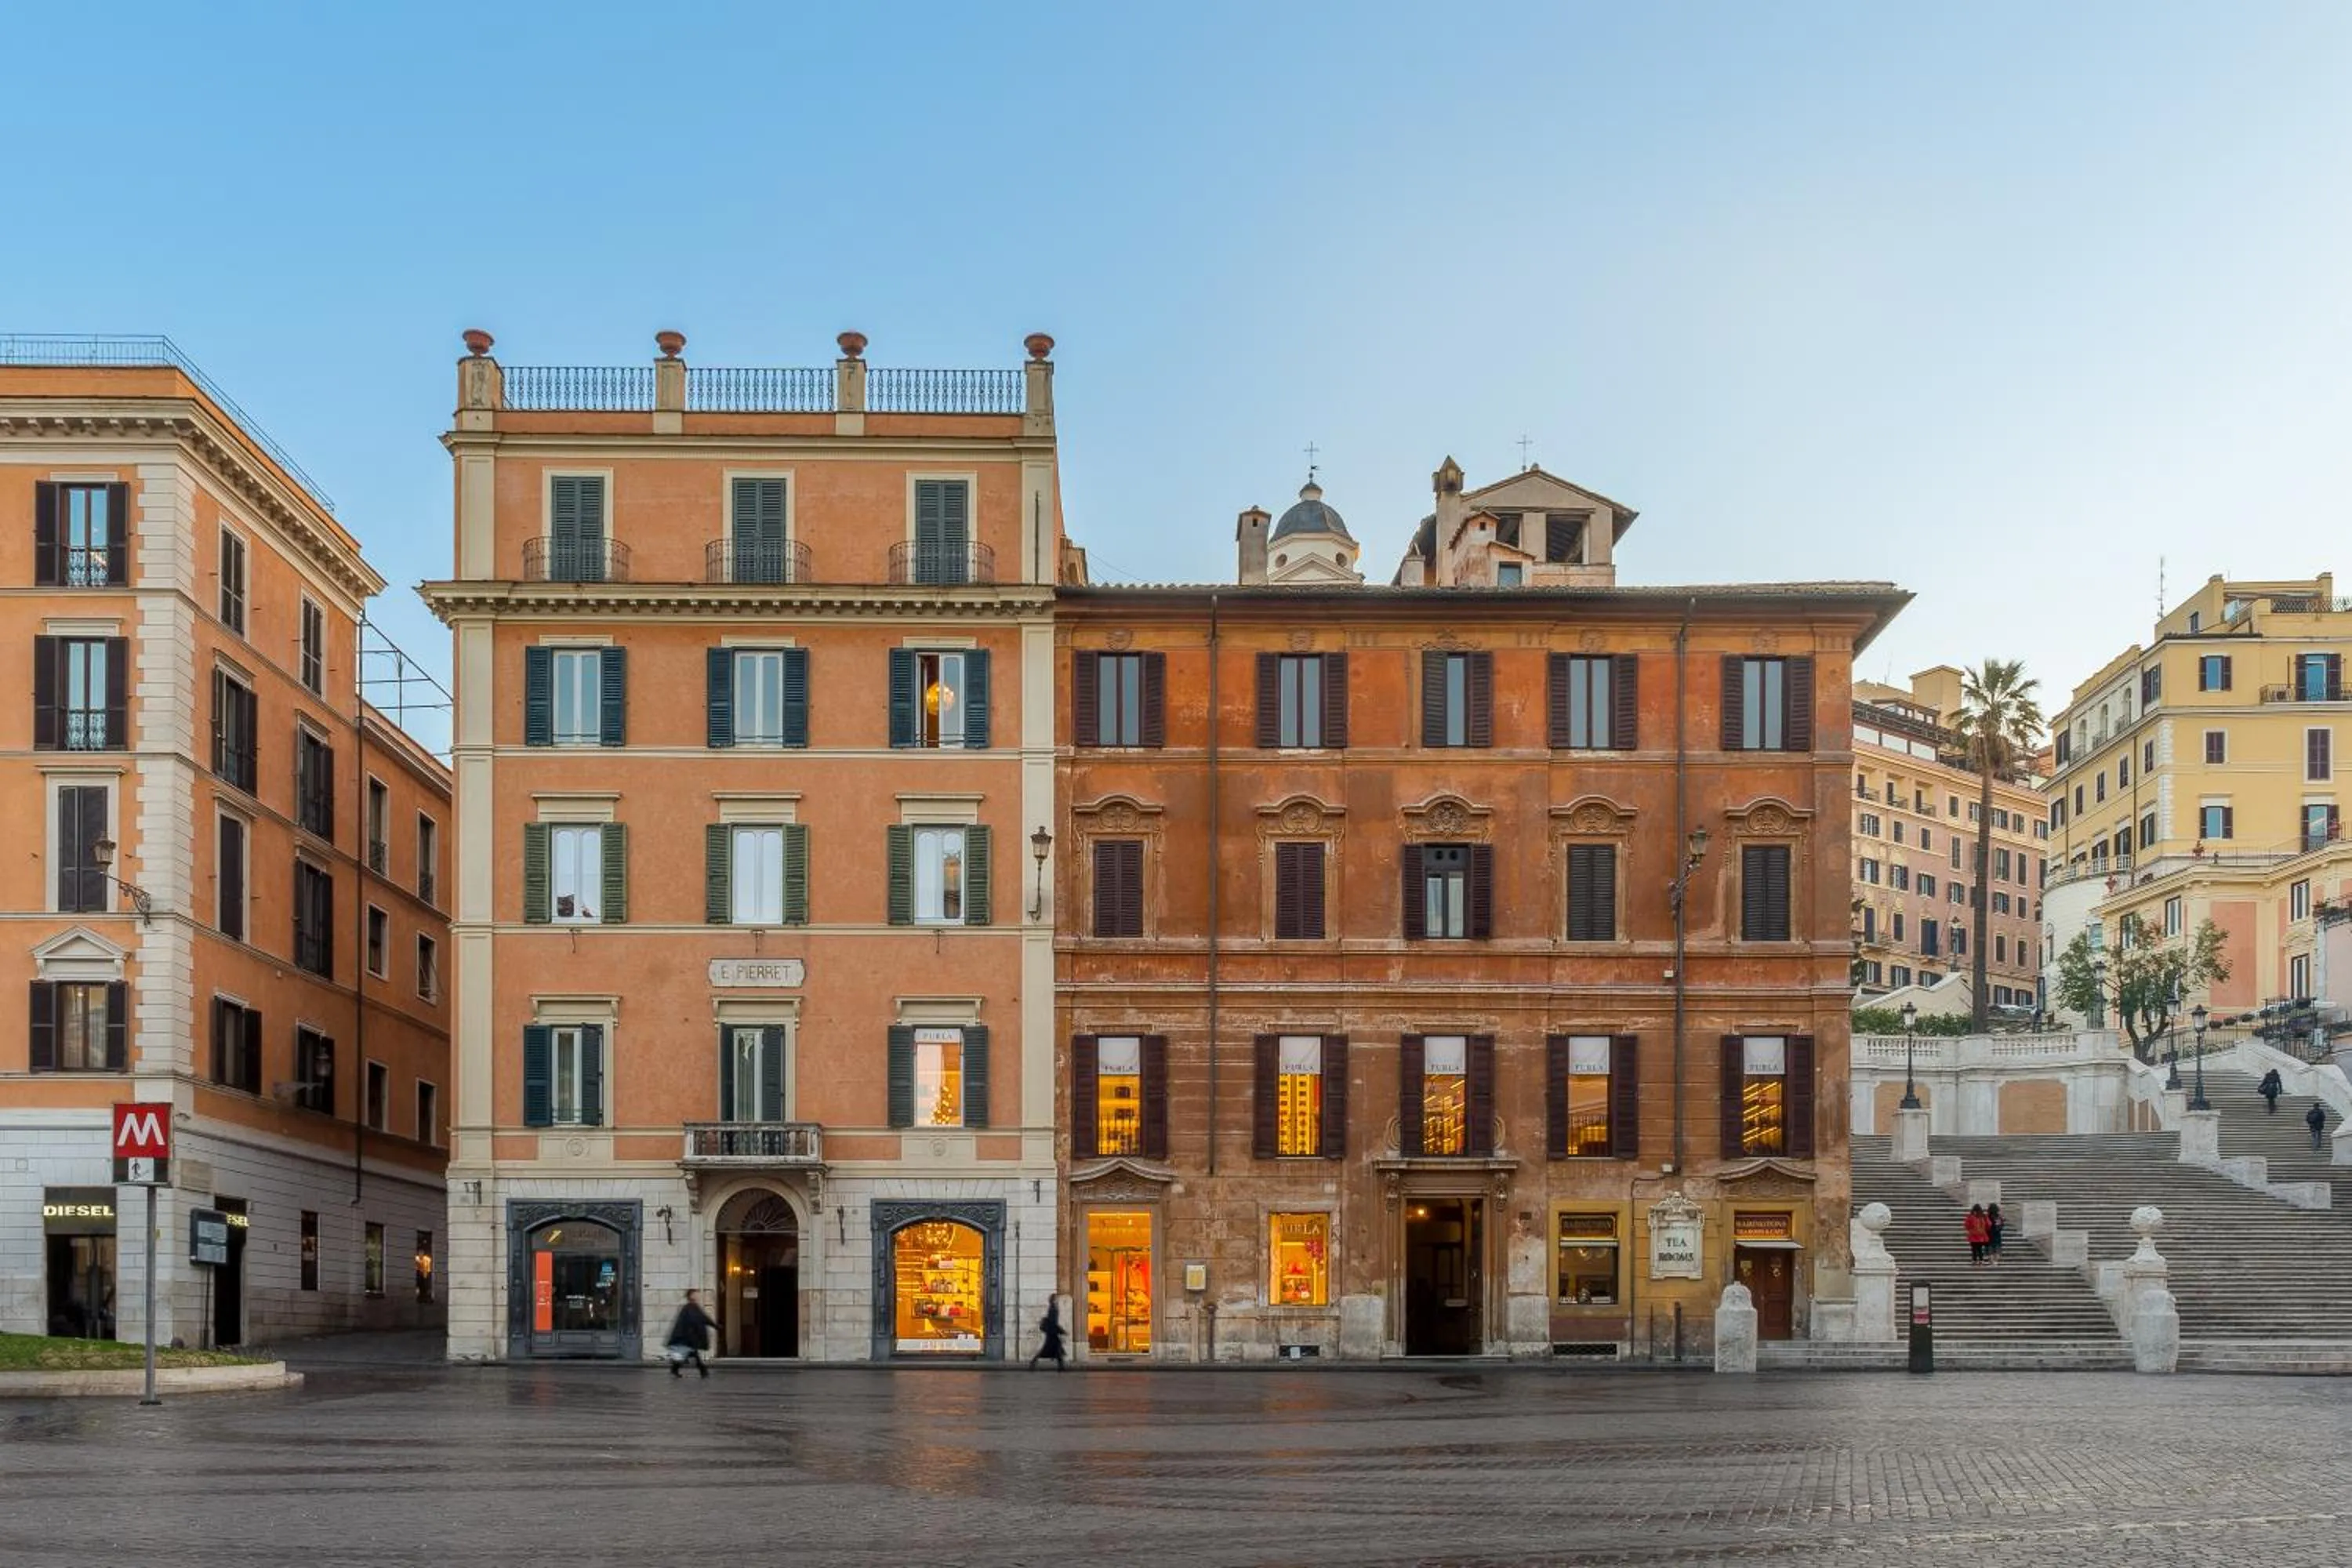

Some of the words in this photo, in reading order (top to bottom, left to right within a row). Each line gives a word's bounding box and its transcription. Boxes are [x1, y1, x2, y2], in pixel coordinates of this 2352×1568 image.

[736, 965, 791, 980] PIERRET
[117, 1112, 165, 1146] M
[43, 1205, 114, 1216] DIESEL
[225, 1213, 249, 1227] ESEL
[1666, 1238, 1687, 1247] TEA
